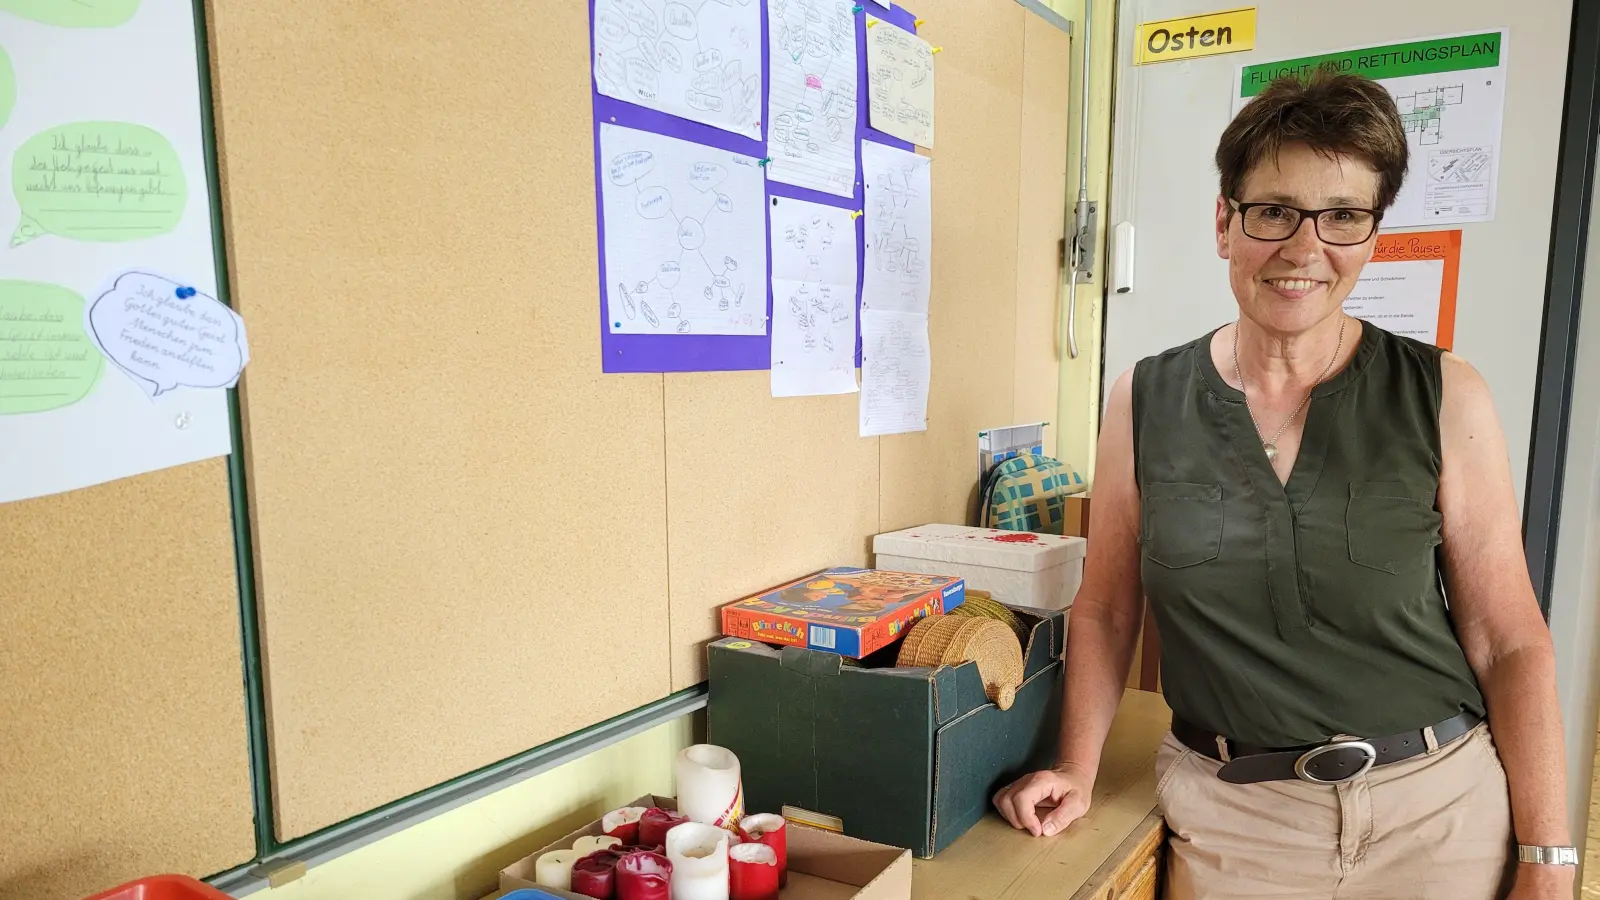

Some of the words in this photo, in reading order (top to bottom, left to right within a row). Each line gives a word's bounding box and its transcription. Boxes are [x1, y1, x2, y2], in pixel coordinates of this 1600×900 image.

[1146, 25, 1232, 54] Osten
[1358, 40, 1495, 70] RETTUNGSPLAN
[1389, 240, 1405, 254] die
[1408, 238, 1447, 254] Pause:
[751, 619, 783, 632] Blinde
[783, 620, 805, 640] Kuh
